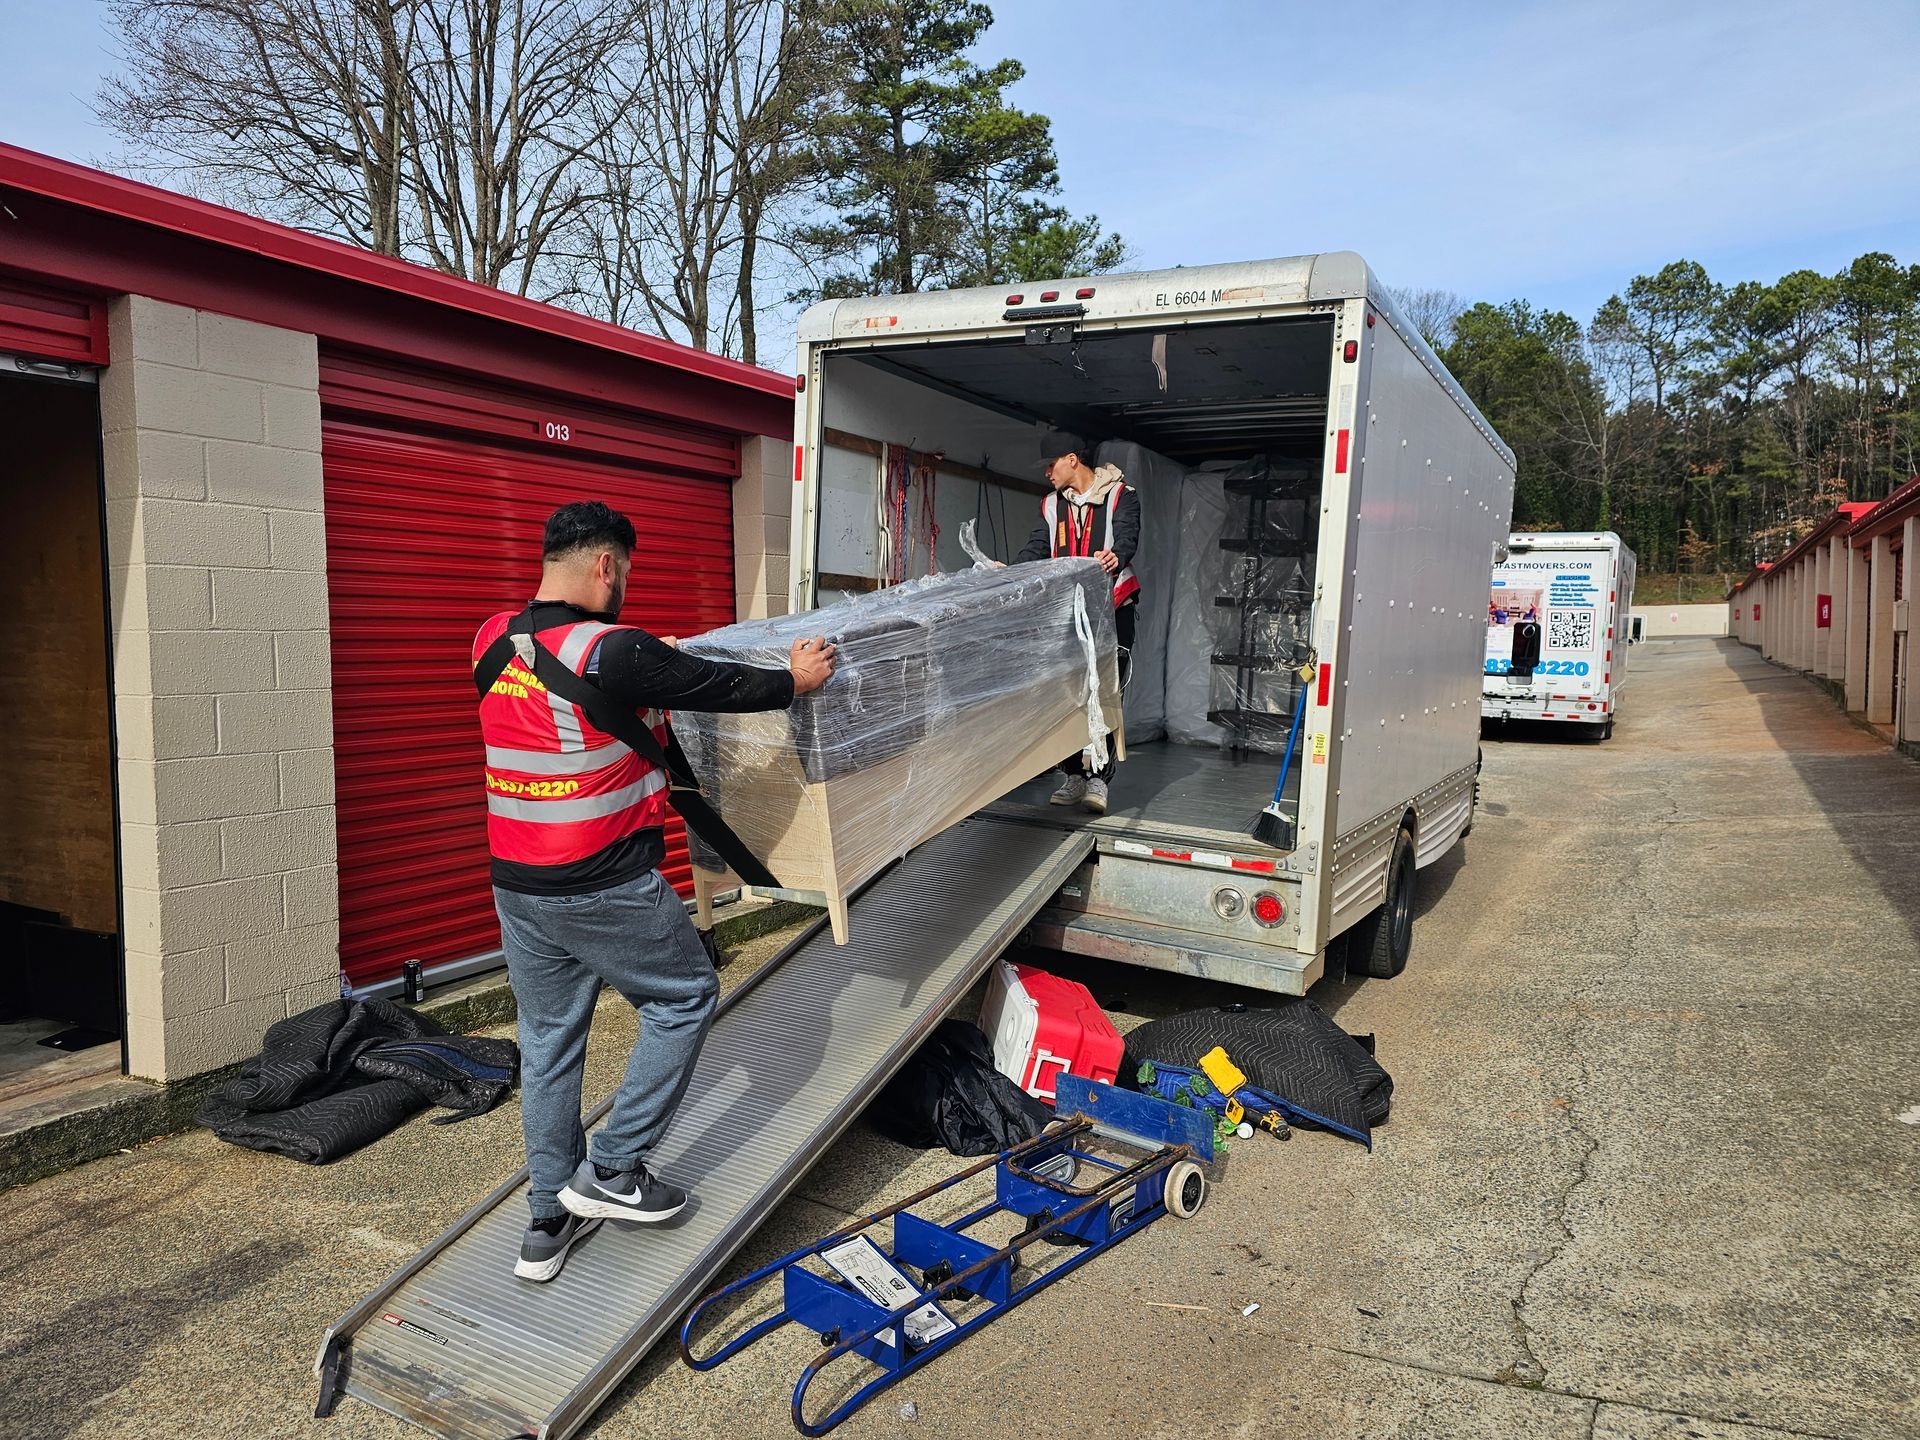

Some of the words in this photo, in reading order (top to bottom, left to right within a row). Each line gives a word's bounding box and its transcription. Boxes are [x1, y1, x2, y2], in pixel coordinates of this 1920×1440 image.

[1156, 294, 1170, 307] EL
[1175, 290, 1206, 305] 6604
[1211, 289, 1222, 303] M
[546, 422, 569, 441] 013
